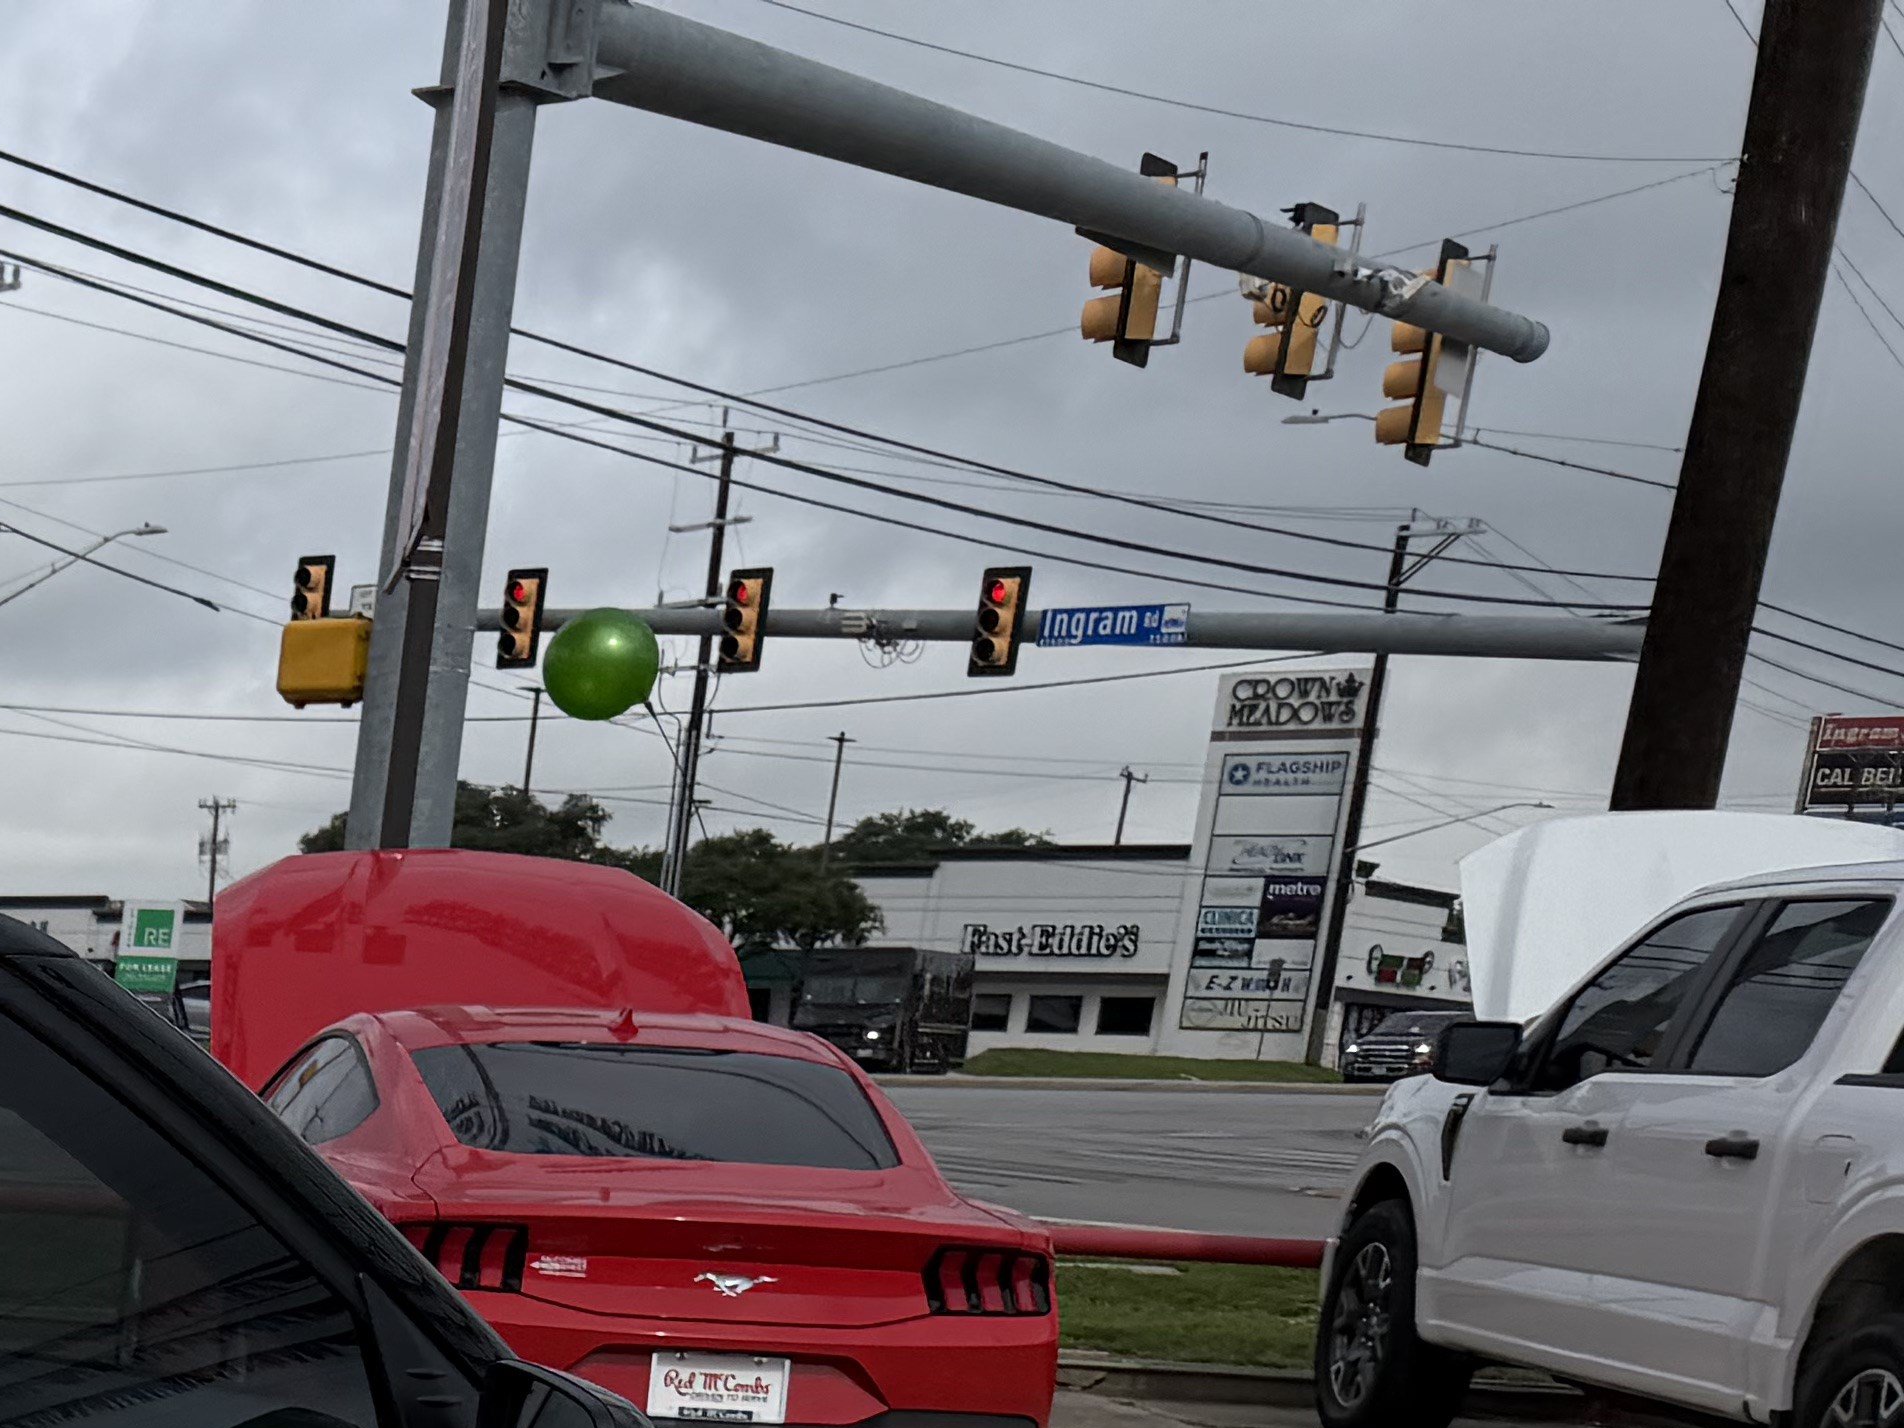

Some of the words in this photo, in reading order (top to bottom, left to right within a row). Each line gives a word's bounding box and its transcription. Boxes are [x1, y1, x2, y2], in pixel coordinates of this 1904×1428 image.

[1043, 609, 1138, 644] Ingram
[1143, 610, 1160, 628] Rd
[1232, 676, 1336, 701] CROWN
[1226, 700, 1356, 727] MEADOWS
[1255, 761, 1342, 775] FLAGSHIP
[1816, 767, 1854, 786] CAL
[1268, 881, 1322, 896] metro
[144, 927, 170, 947] RE
[663, 1368, 696, 1397] Red
[699, 1372, 772, 1396] McCombs
